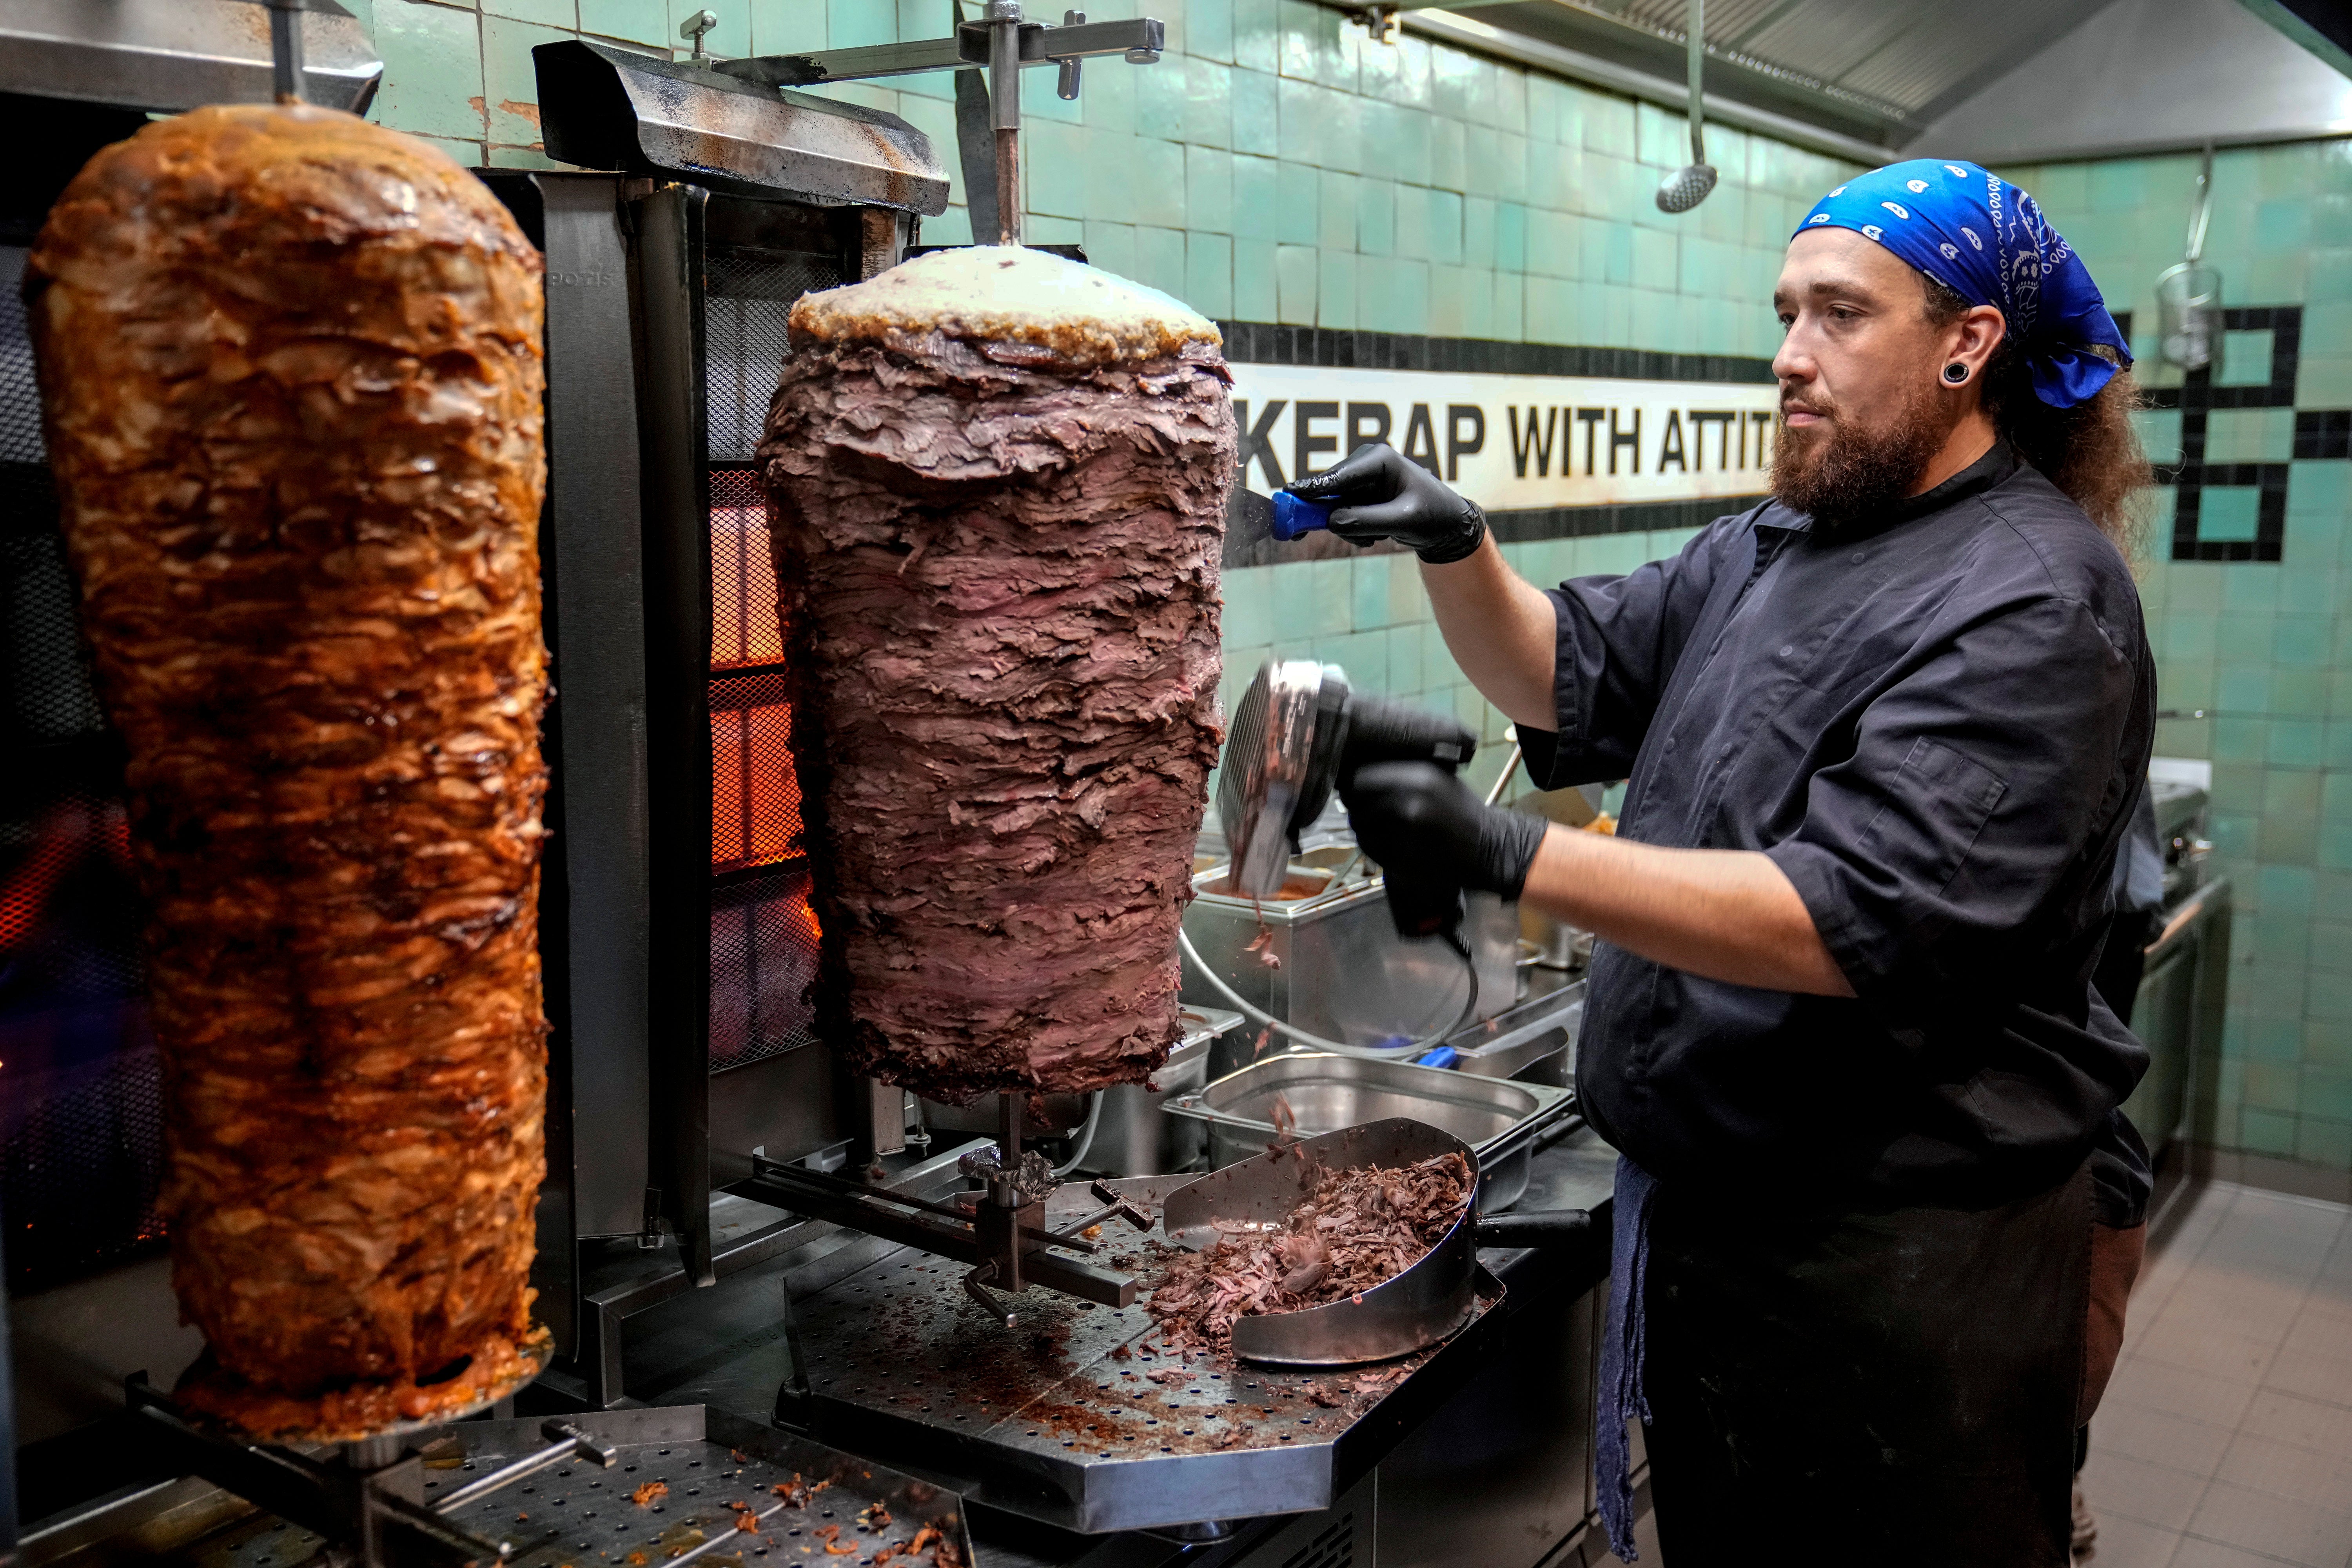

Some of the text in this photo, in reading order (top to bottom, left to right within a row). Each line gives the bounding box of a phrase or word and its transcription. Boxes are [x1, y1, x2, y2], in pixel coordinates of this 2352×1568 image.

[1233, 399, 1780, 489] KEBAP WITH ATTIT
